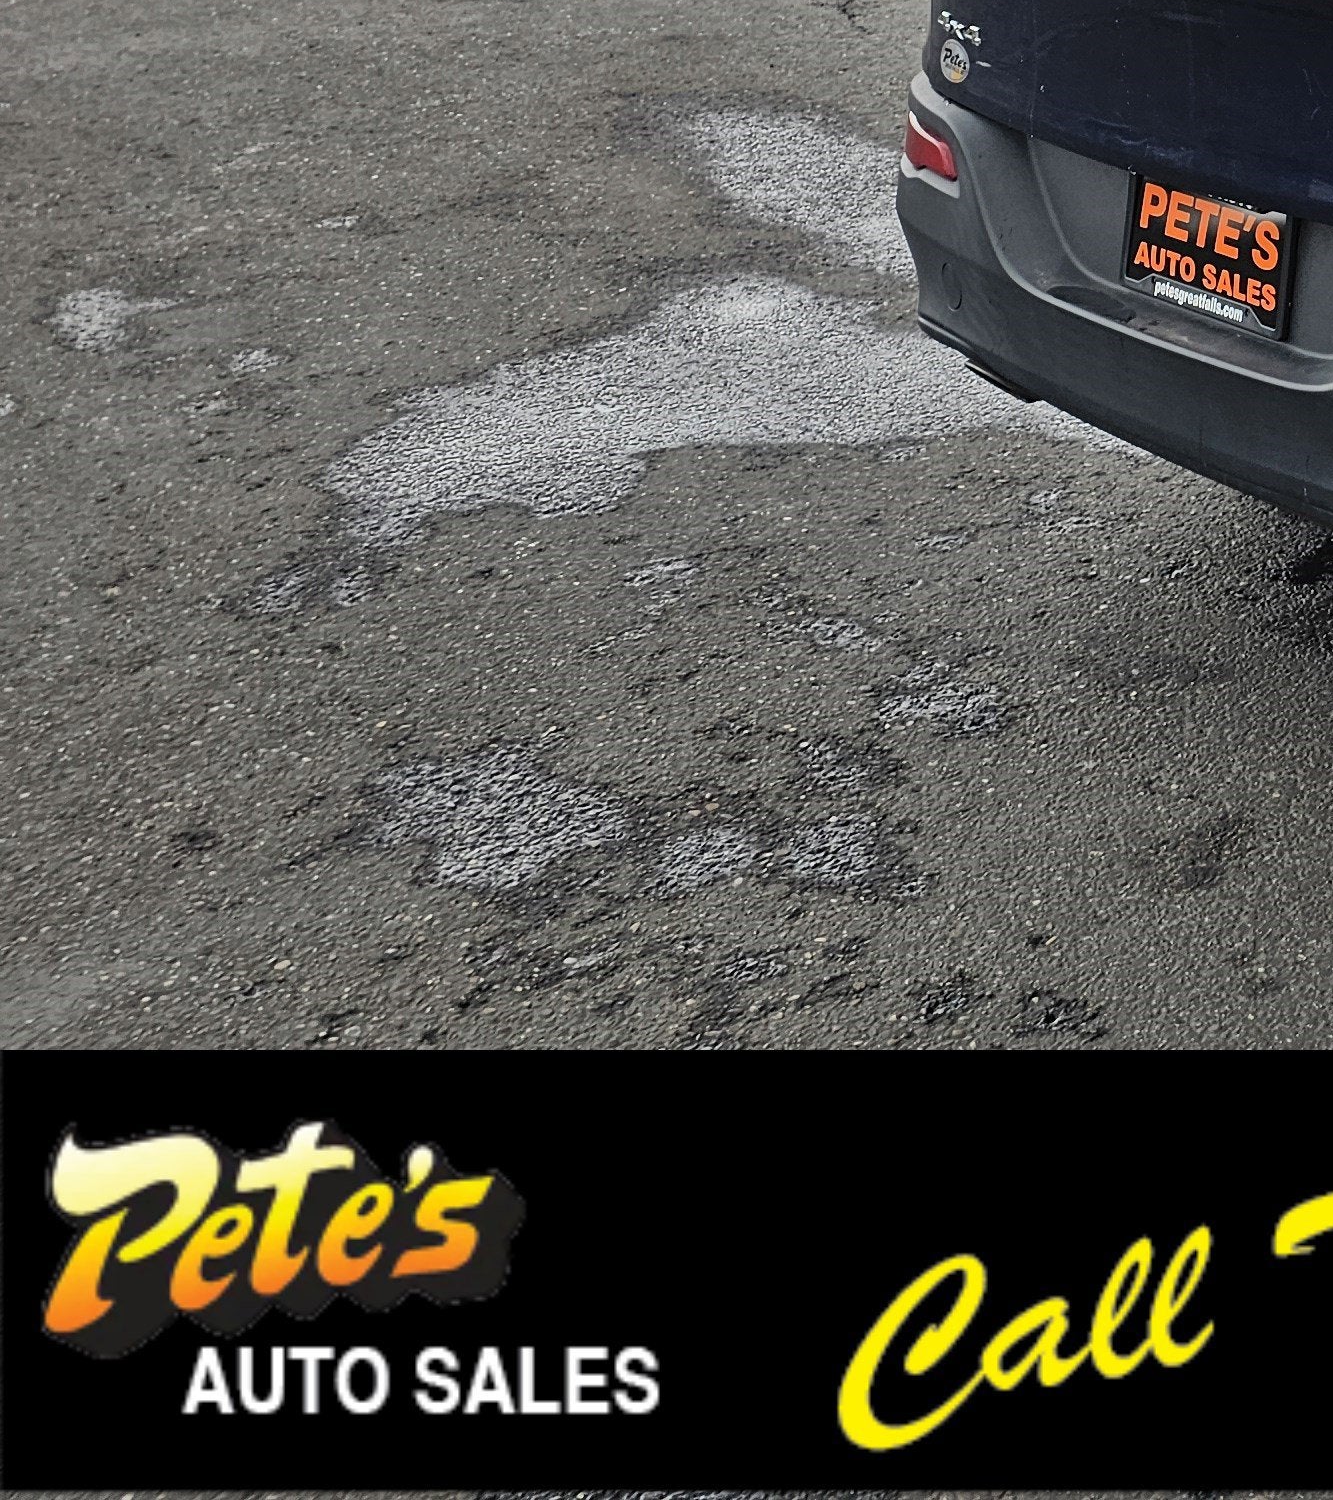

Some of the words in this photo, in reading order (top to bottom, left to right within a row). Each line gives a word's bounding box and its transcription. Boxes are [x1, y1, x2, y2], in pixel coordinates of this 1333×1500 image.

[1139, 181, 1281, 271] PETE'S
[1133, 241, 1197, 284] AUTO
[1202, 263, 1277, 312] SALES
[1153, 279, 1245, 323] petesgreatfalls.com
